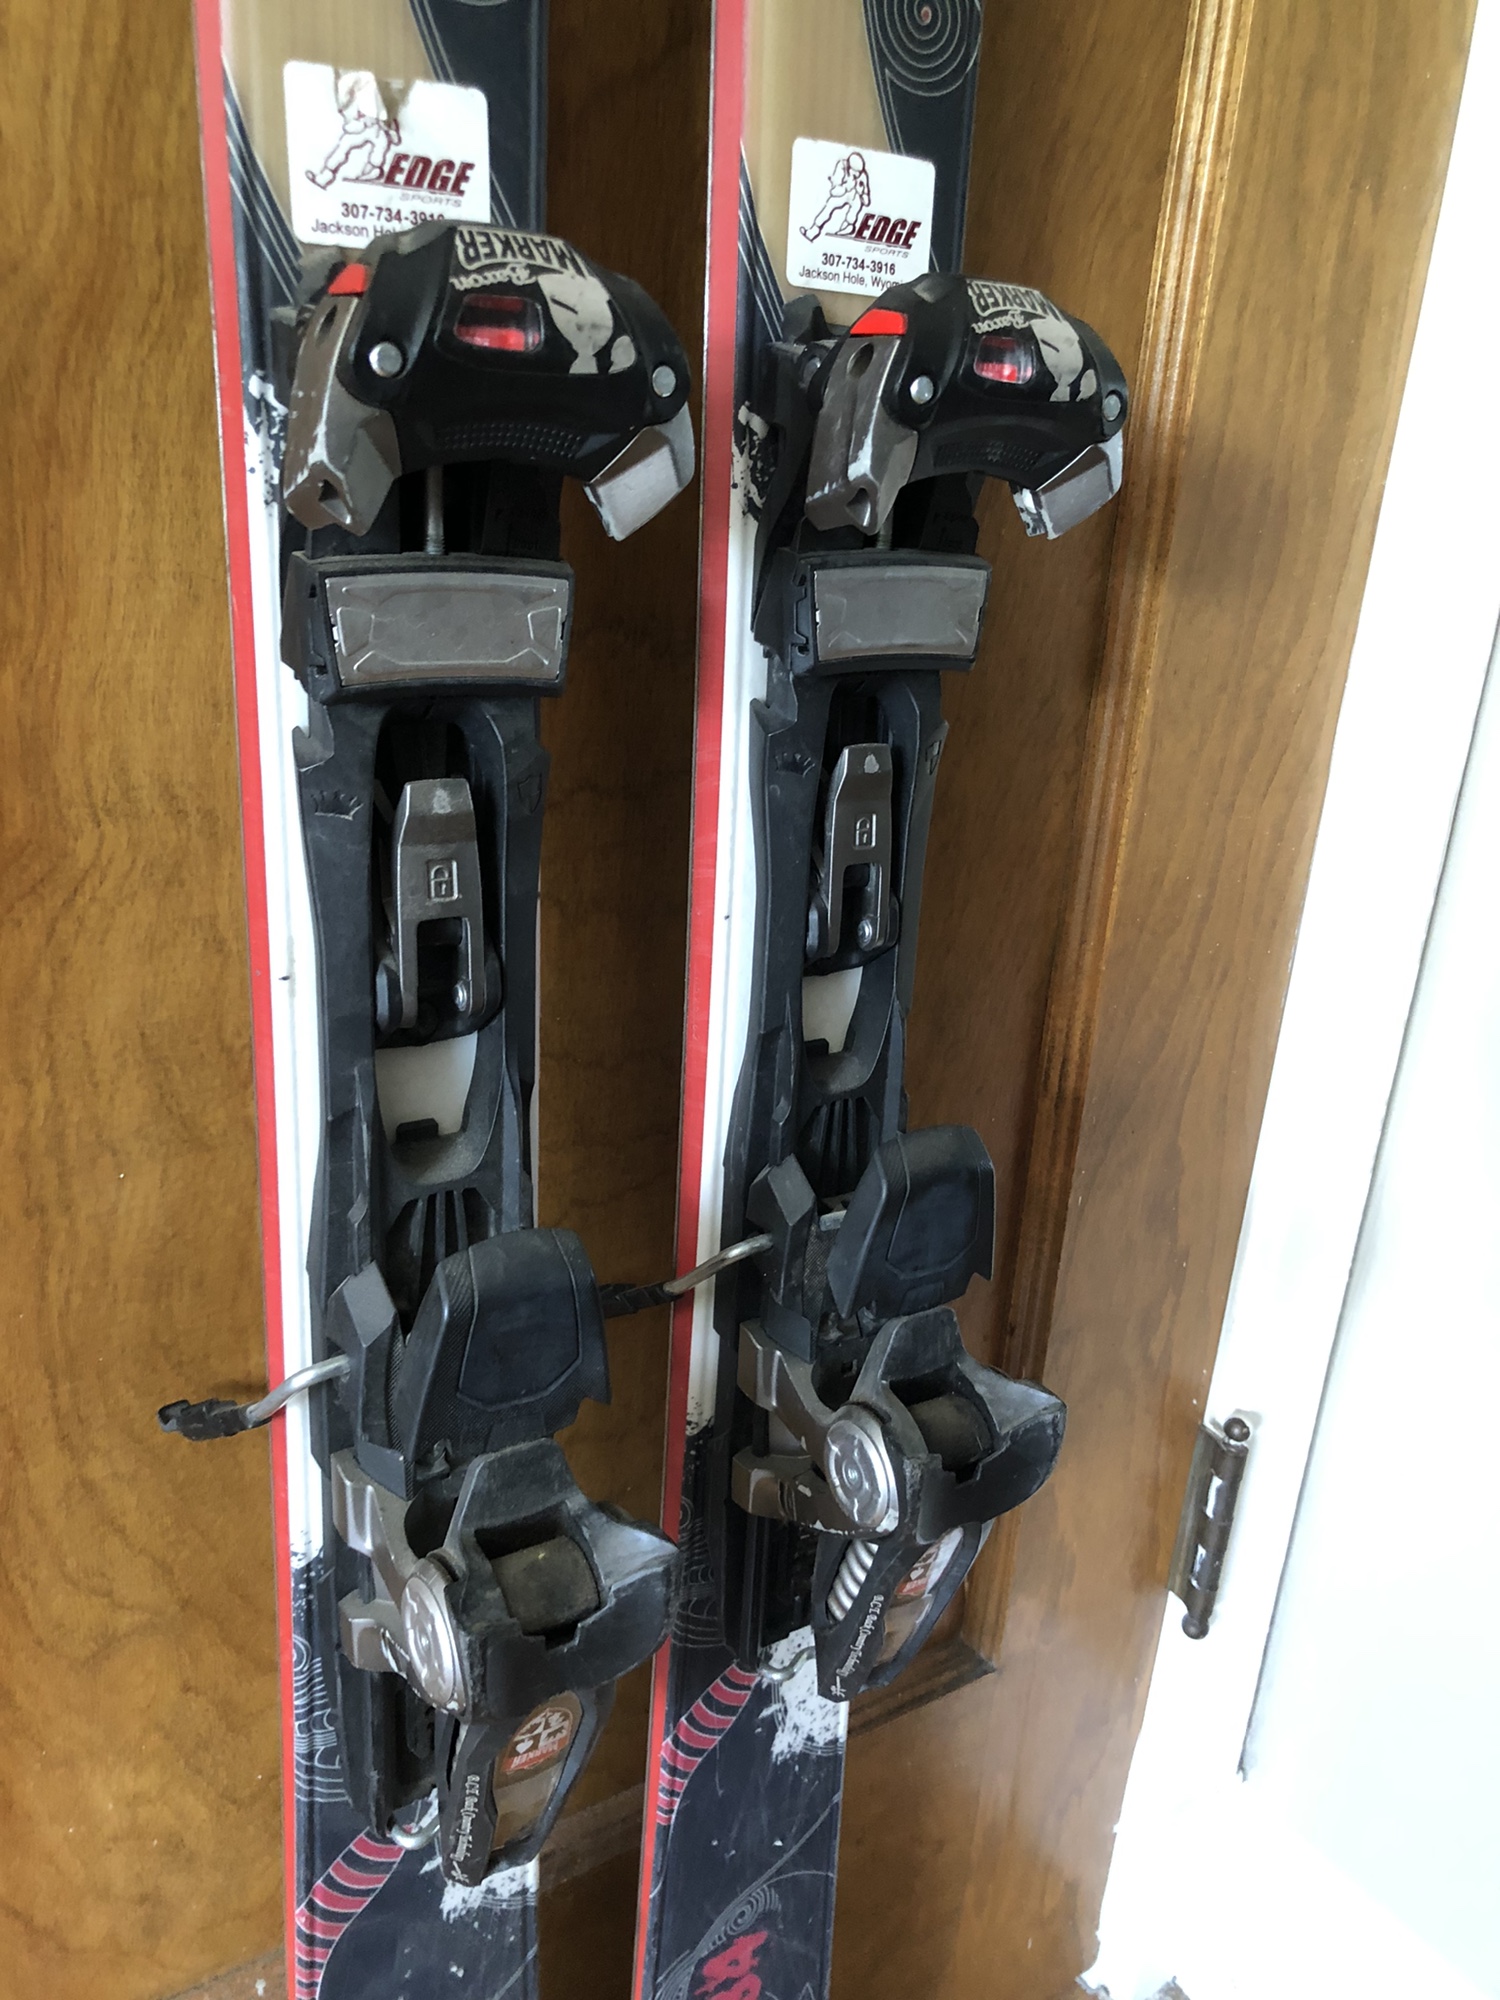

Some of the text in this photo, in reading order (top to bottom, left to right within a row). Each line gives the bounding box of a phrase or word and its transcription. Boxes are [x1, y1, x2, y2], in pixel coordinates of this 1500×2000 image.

[384, 152, 476, 197] EDGE
[399, 192, 463, 208] SPORTS
[311, 218, 370, 239] Jackson
[854, 212, 922, 250] EDGE
[456, 229, 586, 279] MARKER
[821, 252, 896, 276] 307-734-3916
[864, 245, 910, 259] SPORTS
[448, 262, 537, 291] Baron
[799, 265, 840, 282] Jackson
[842, 271, 868, 288] Hole,
[967, 282, 1061, 322] MARKER
[971, 309, 1030, 334] Baron
